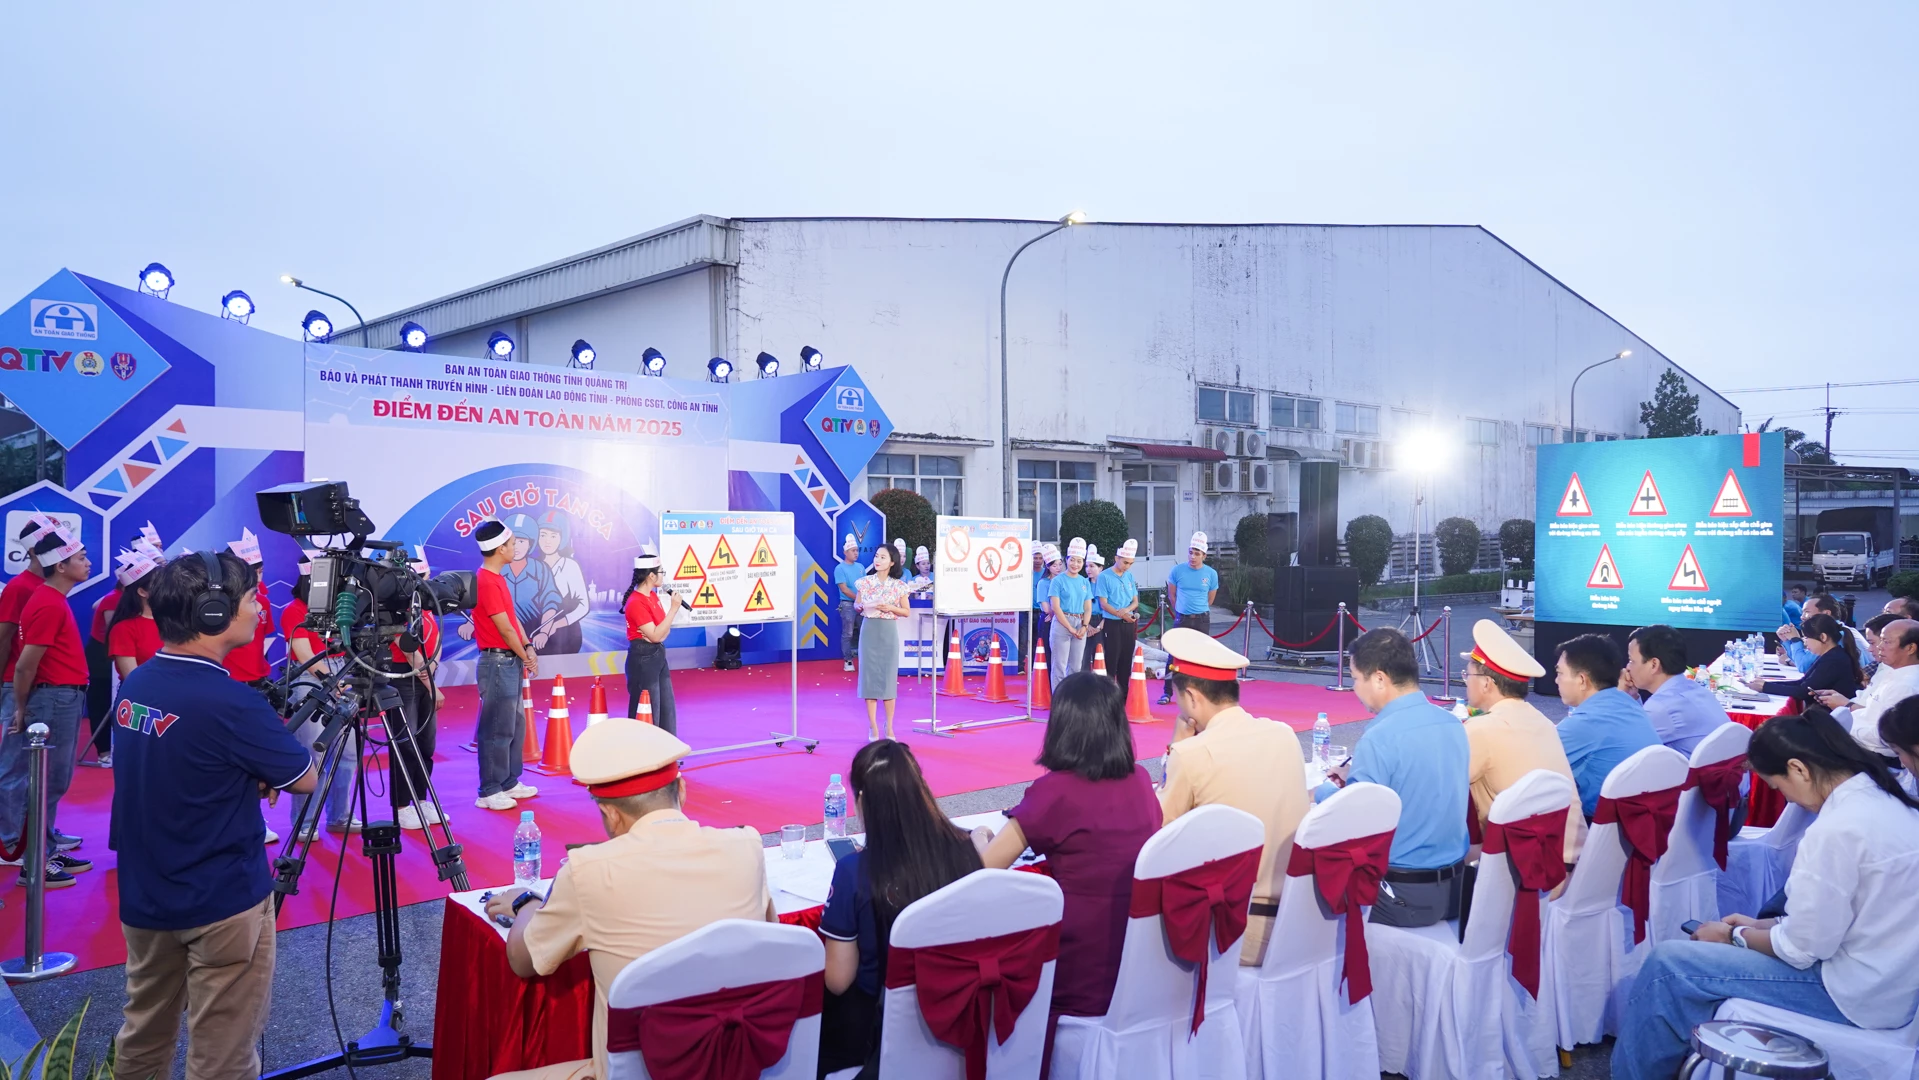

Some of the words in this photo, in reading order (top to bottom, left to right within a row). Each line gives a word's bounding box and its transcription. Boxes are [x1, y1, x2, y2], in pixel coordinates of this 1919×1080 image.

[0, 346, 73, 373] QTTV
[445, 363, 465, 376] BAN
[467, 366, 481, 377] AN
[483, 366, 507, 379] TOÀN
[510, 370, 530, 381] GIAO
[533, 371, 561, 384] THÔNG
[585, 375, 613, 389] QUẢNG
[615, 380, 628, 392] TRỊ
[320, 368, 342, 382] BÁO
[344, 371, 358, 384] VÀ
[361, 373, 388, 386] PHÁT
[390, 376, 423, 389] THANH
[465, 381, 488, 394] HÌNH
[496, 384, 517, 397] LIÊN
[519, 386, 543, 399] ĐOÀN
[545, 389, 561, 400] LAO
[563, 390, 587, 403] ĐỘNG
[615, 395, 643, 407] PHÒNG
[667, 399, 688, 411] CÔNG
[689, 402, 700, 412] AN
[373, 395, 432, 420] ĐIỂM
[437, 398, 483, 423] ĐẾN
[488, 408, 519, 426] AN
[523, 408, 584, 431] TOÀN
[588, 413, 632, 433] NĂM
[636, 419, 682, 437] 2025
[821, 417, 854, 433] QTTV
[454, 496, 496, 538] SAU
[499, 482, 541, 510] GIỜ
[544, 489, 590, 519] TAN
[587, 509, 613, 541] CA
[116, 699, 180, 737] QTTV
